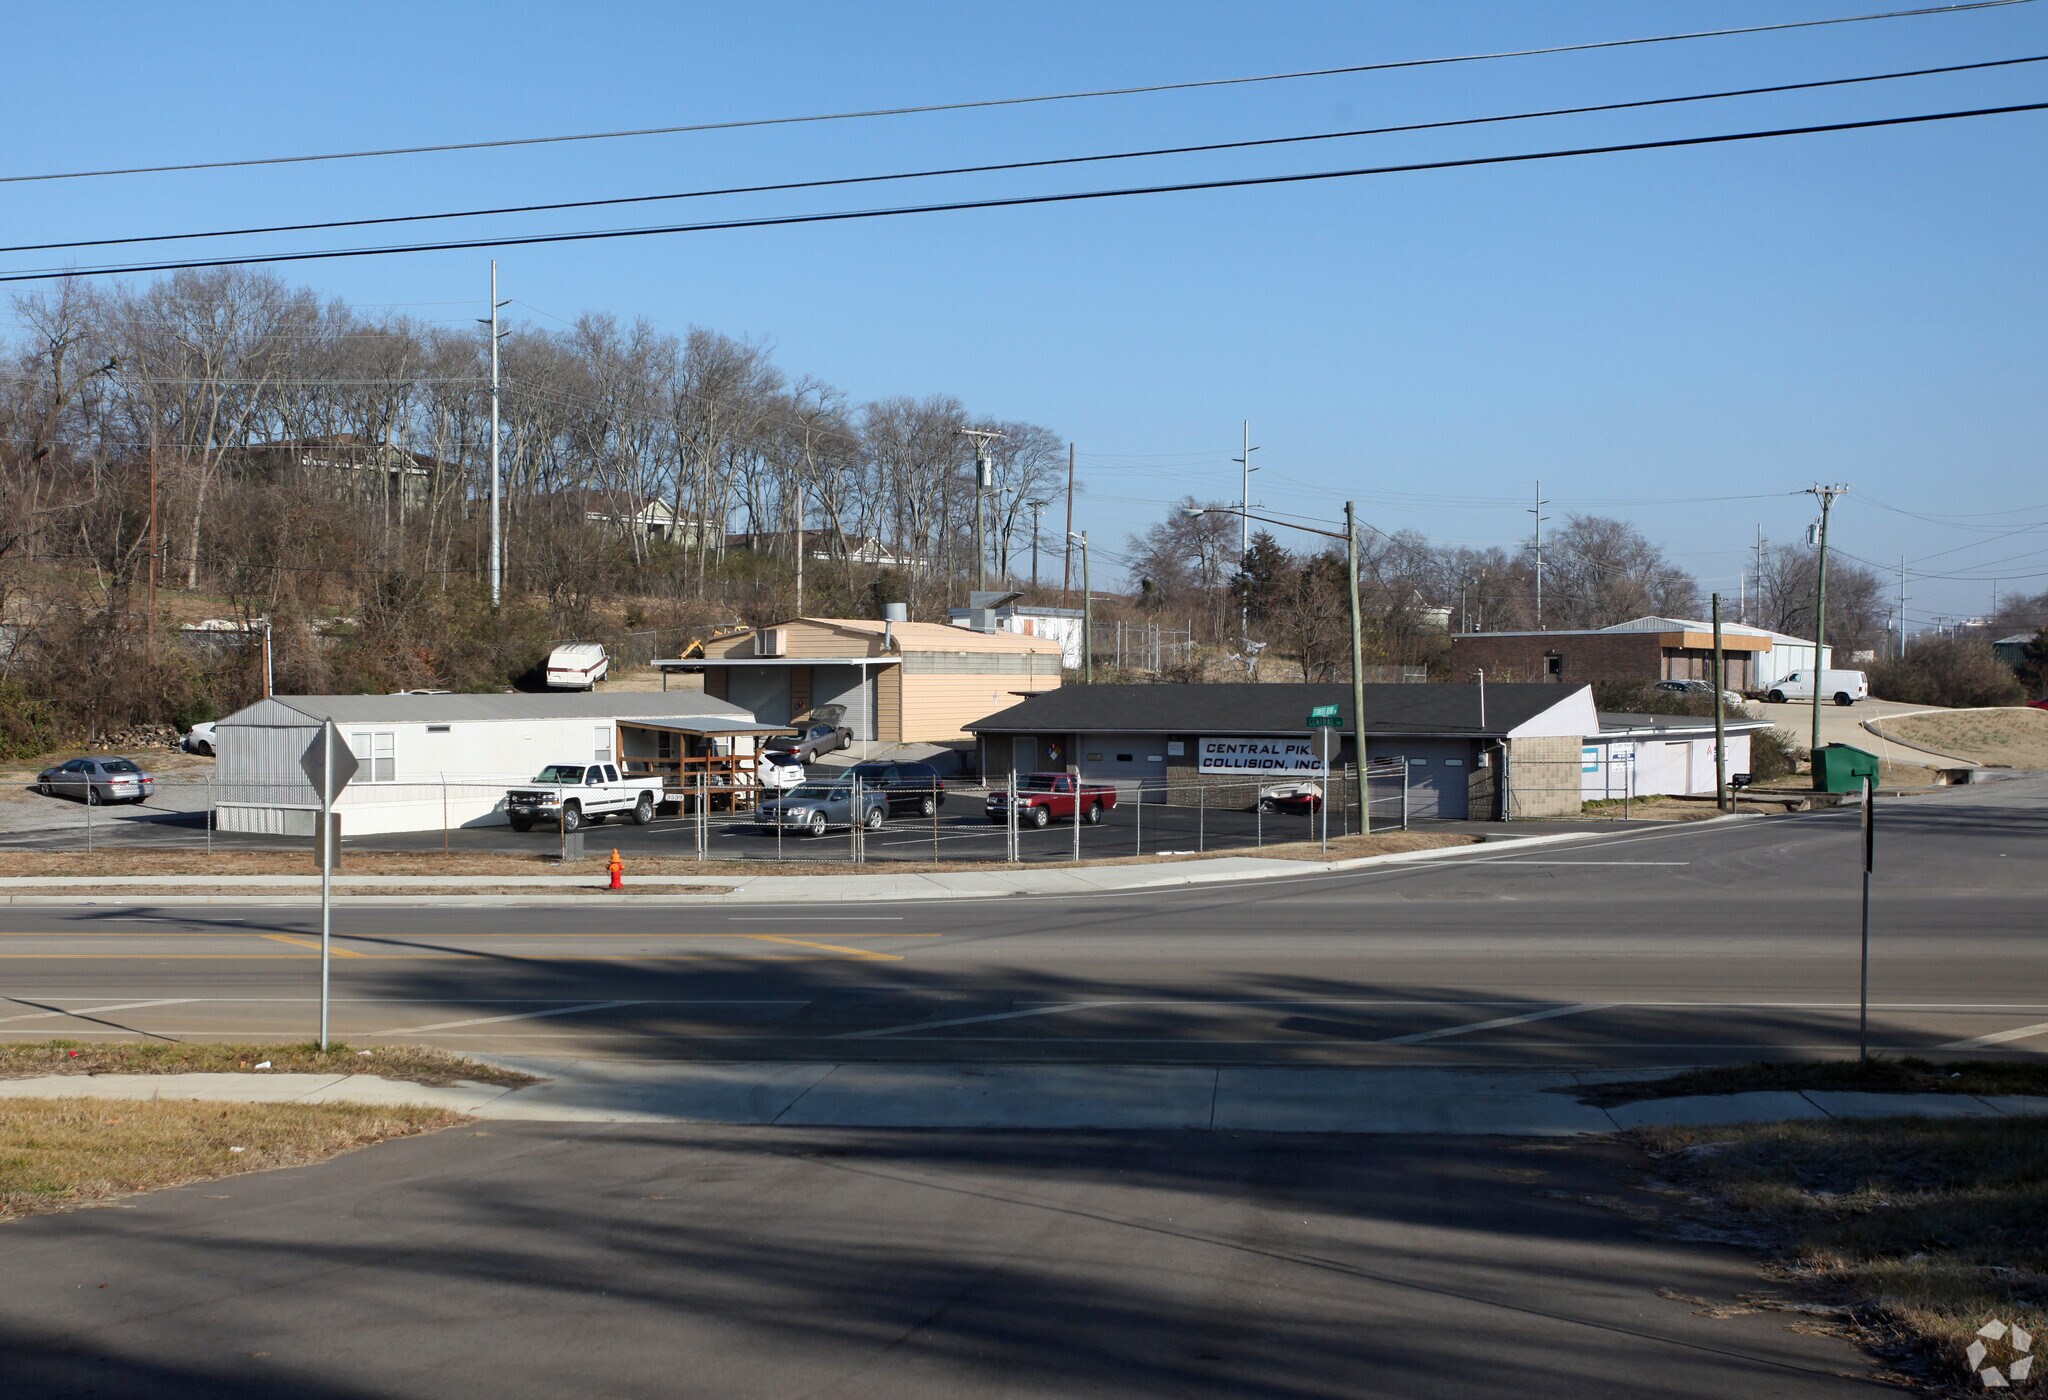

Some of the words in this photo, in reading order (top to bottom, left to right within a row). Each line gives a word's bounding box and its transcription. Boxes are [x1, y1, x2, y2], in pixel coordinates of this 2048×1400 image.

[1308, 718, 1334, 726] CENTRAL
[1206, 744, 1280, 755] CENTRAL
[1285, 745, 1315, 755] PIK
[1203, 758, 1288, 771] COLLISION,
[1294, 760, 1324, 770] INC.
